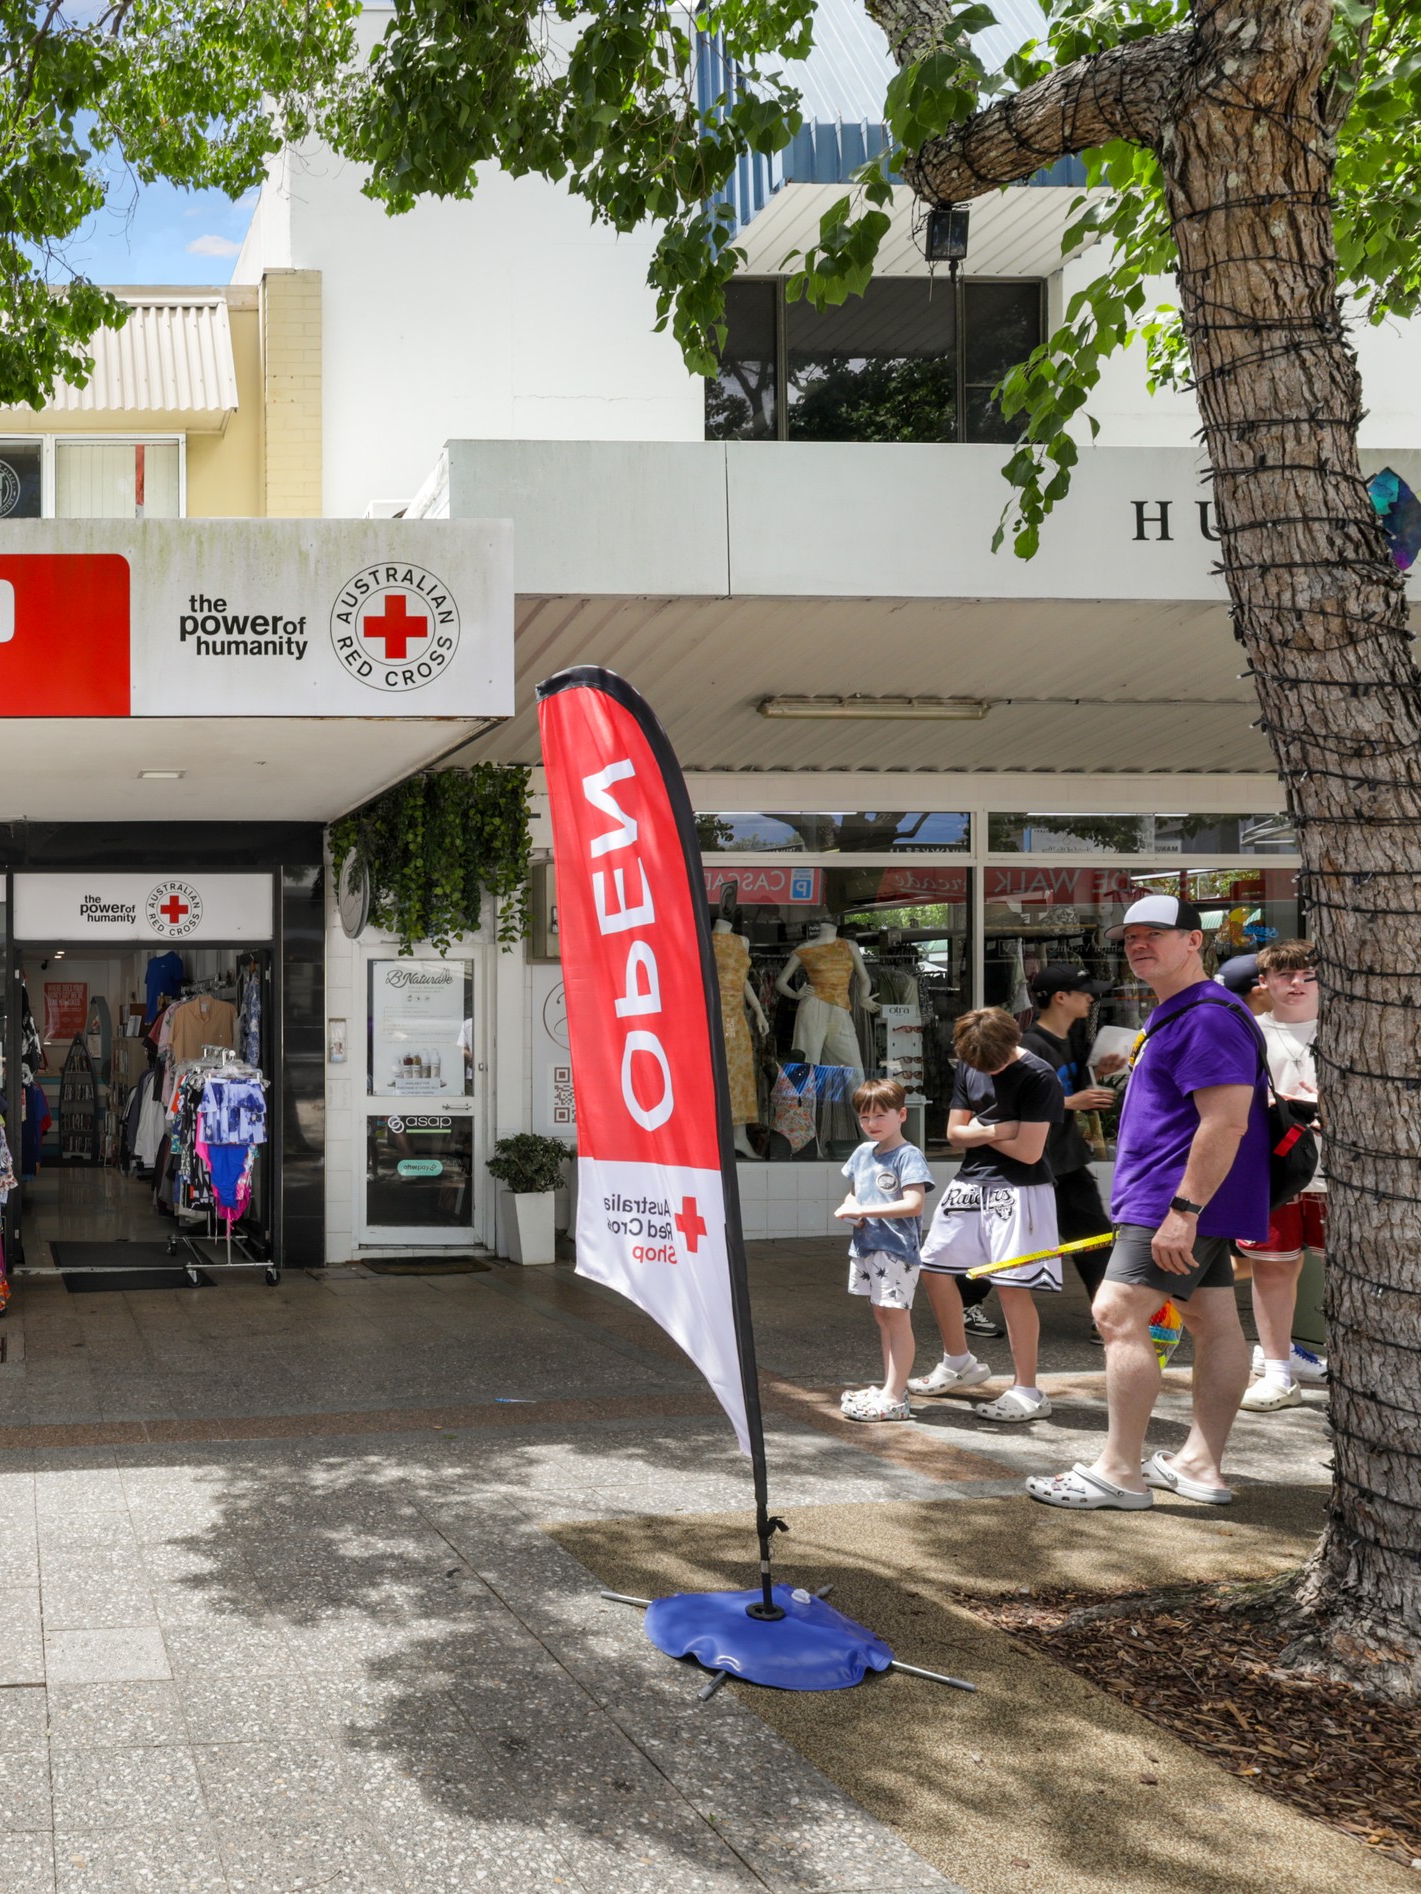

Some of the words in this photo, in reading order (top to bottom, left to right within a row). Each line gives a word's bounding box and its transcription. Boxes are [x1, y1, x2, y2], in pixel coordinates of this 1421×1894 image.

[189, 594, 227, 613] the
[336, 567, 454, 625] AUSTRALIAN
[180, 614, 283, 641] power
[283, 616, 307, 635] of
[196, 636, 308, 660] humanity
[337, 636, 373, 677] RED
[385, 635, 453, 687] CROSS
[84, 895, 101, 904] the
[148, 882, 200, 909] AUSTRALIAN
[80, 903, 126, 915] power
[87, 913, 136, 924] humanity
[148, 913, 165, 932] RED
[169, 913, 200, 936] CROSS
[889, 1006, 910, 1015] otra
[405, 1116, 452, 1128] asap
[941, 1188, 1013, 1207] Raidrs
